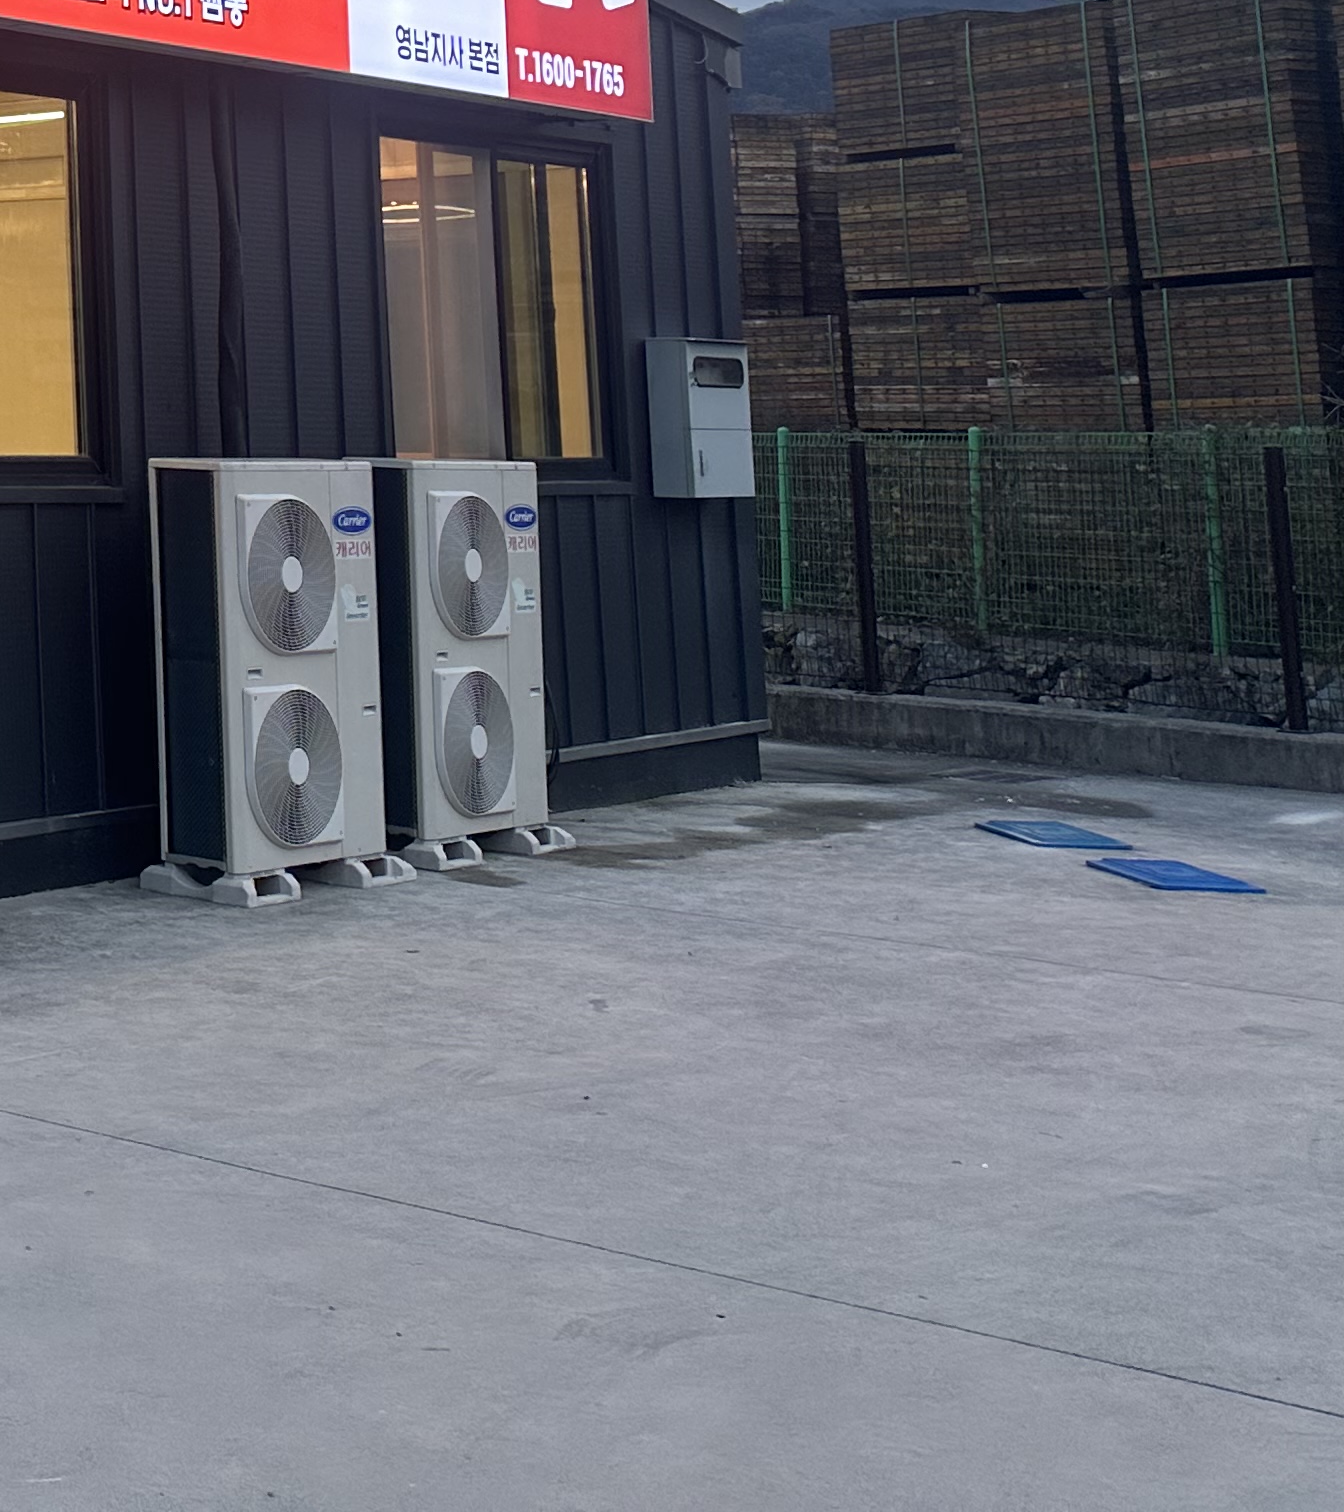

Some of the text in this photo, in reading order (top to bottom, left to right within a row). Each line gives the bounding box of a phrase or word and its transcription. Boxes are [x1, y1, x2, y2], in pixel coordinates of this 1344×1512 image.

[395, 24, 500, 75] 영남지사 본점
[514, 46, 625, 97] T.1600-1765
[337, 513, 368, 527] Carrier
[509, 509, 534, 523] Carrier
[335, 541, 372, 557] 캐리어
[507, 535, 537, 551] 캐리어
